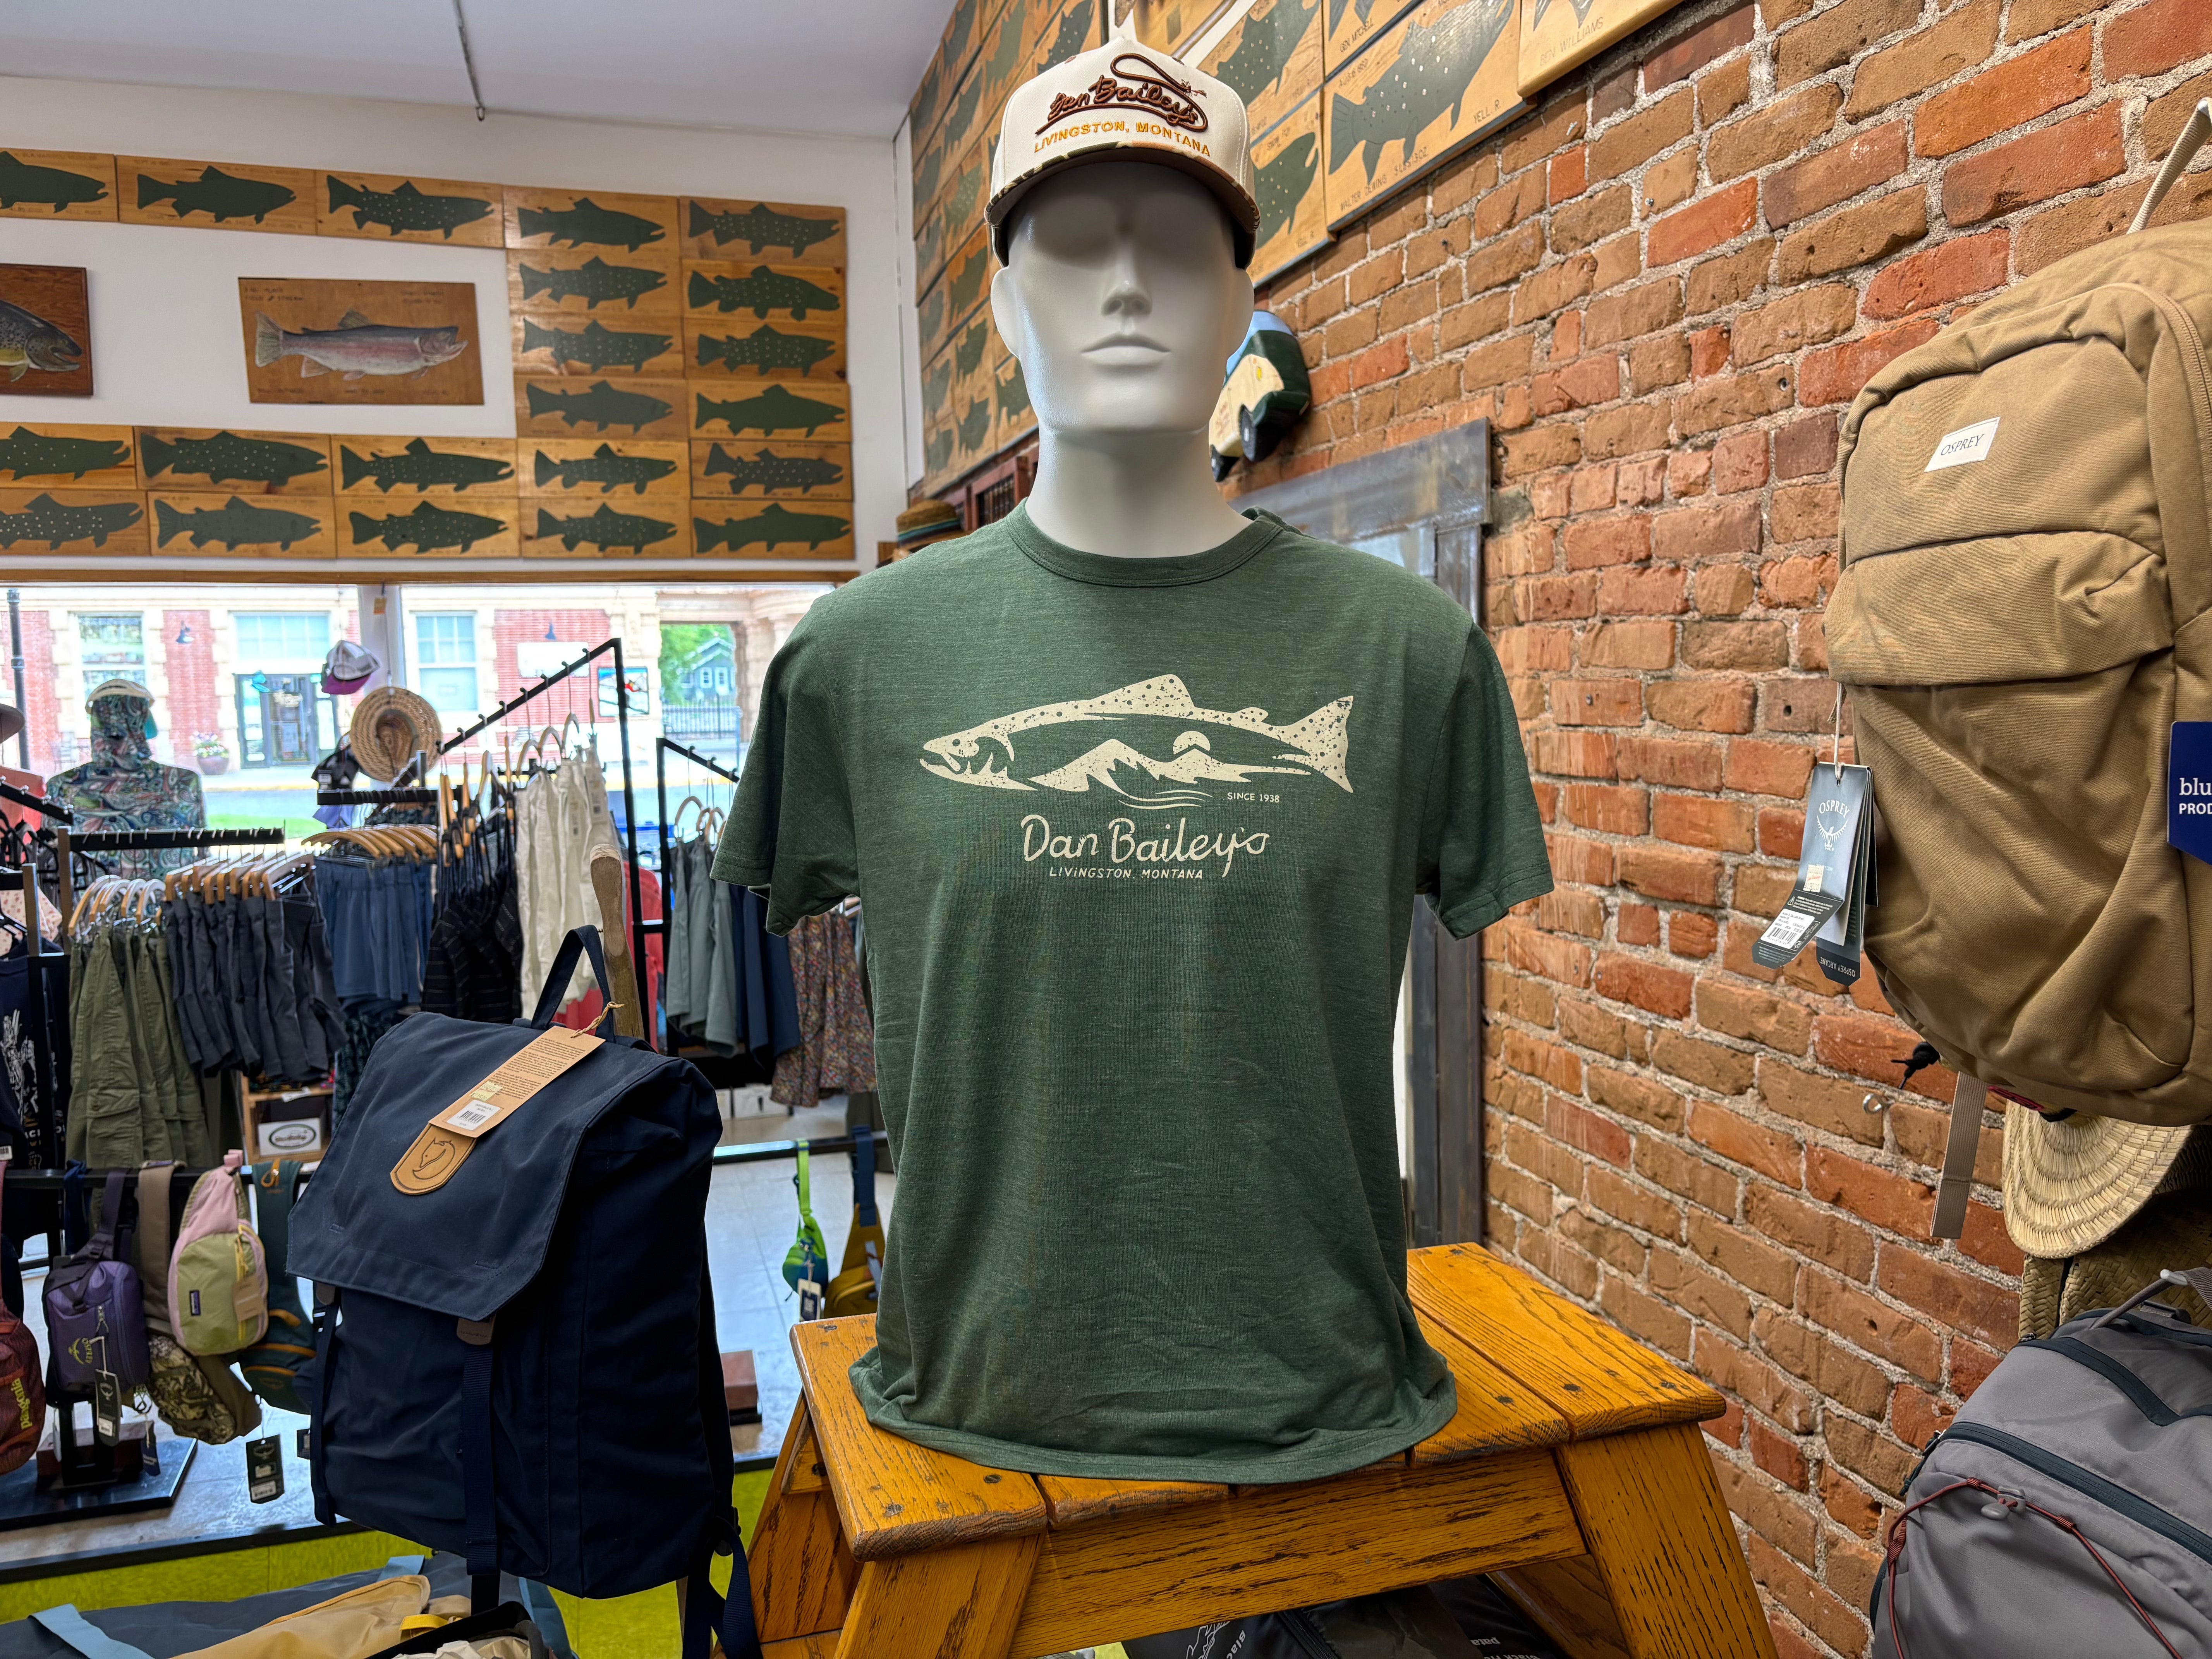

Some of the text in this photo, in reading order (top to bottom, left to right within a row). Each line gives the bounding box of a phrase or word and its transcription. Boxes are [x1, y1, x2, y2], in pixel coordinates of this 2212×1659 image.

[1559, 16, 1604, 53] WILLIAMS
[1034, 121, 1211, 158] LIVINGSTON, MONTANA
[1941, 434, 1985, 456] OSPREY
[1227, 792, 1279, 803] SINCE 1938
[1819, 800, 1850, 818] OSPREY
[1021, 814, 1270, 879] Dan Bailey's
[1142, 869, 1202, 879] MONTANA
[1819, 957, 1855, 977] OSPREY ARCANE
[11, 1377, 33, 1430] patagonia
